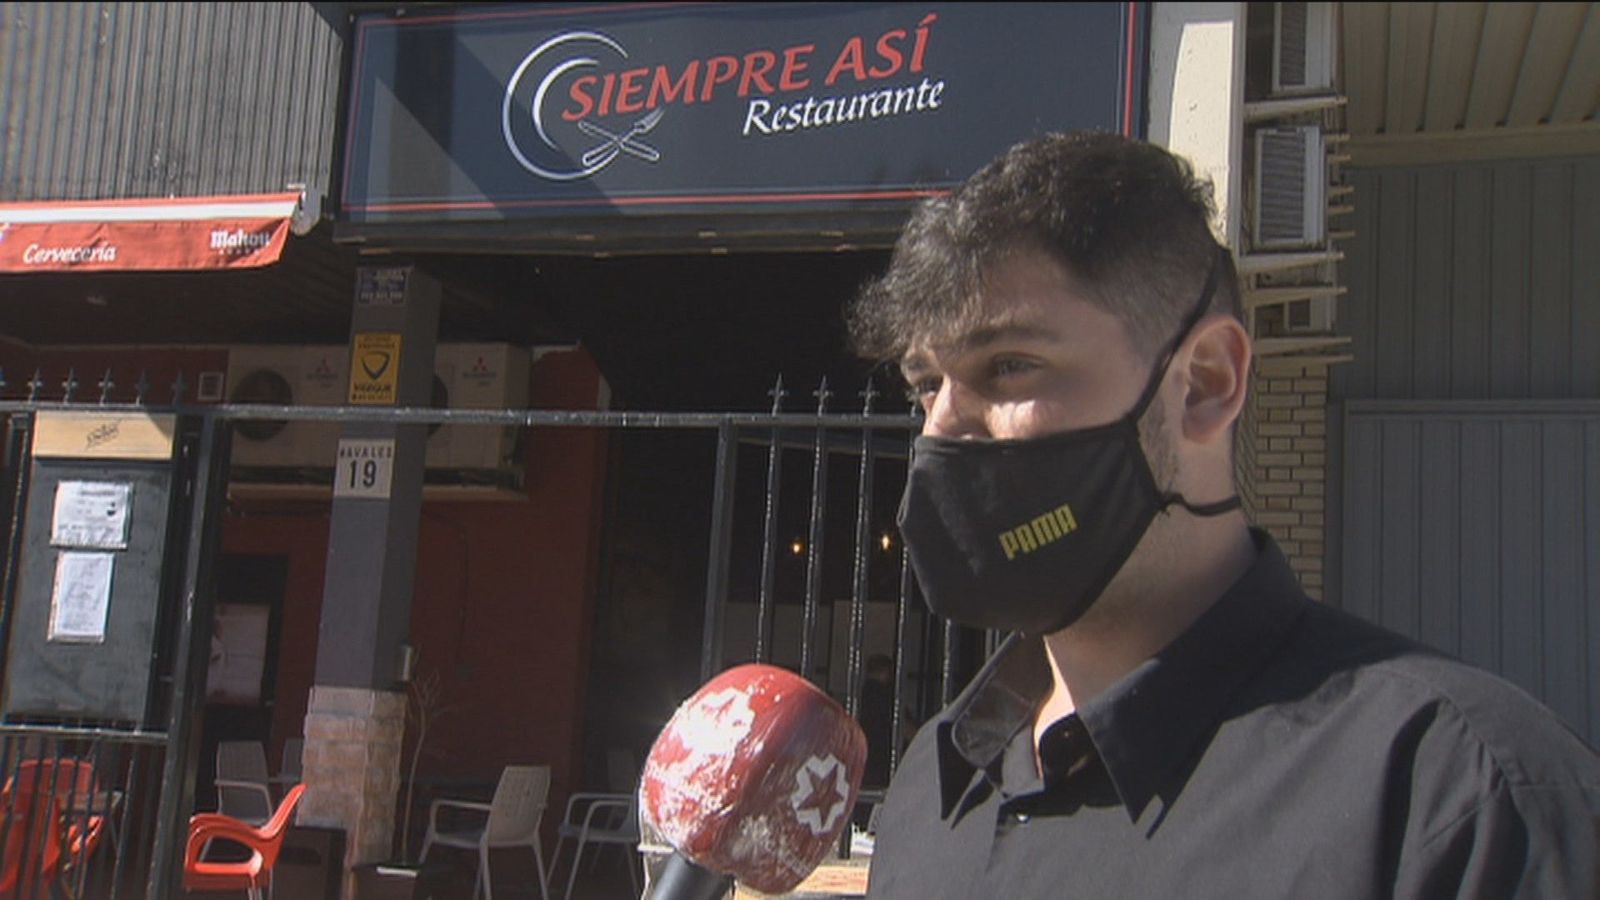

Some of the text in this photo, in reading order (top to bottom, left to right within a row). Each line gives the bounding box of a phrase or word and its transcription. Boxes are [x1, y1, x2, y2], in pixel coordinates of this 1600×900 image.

[562, 13, 937, 121] SIEMPRE ASÍ
[742, 77, 945, 136] Restaurante
[22, 241, 117, 265] Cervecería
[350, 460, 377, 489] 19
[998, 503, 1078, 560] PAMA
